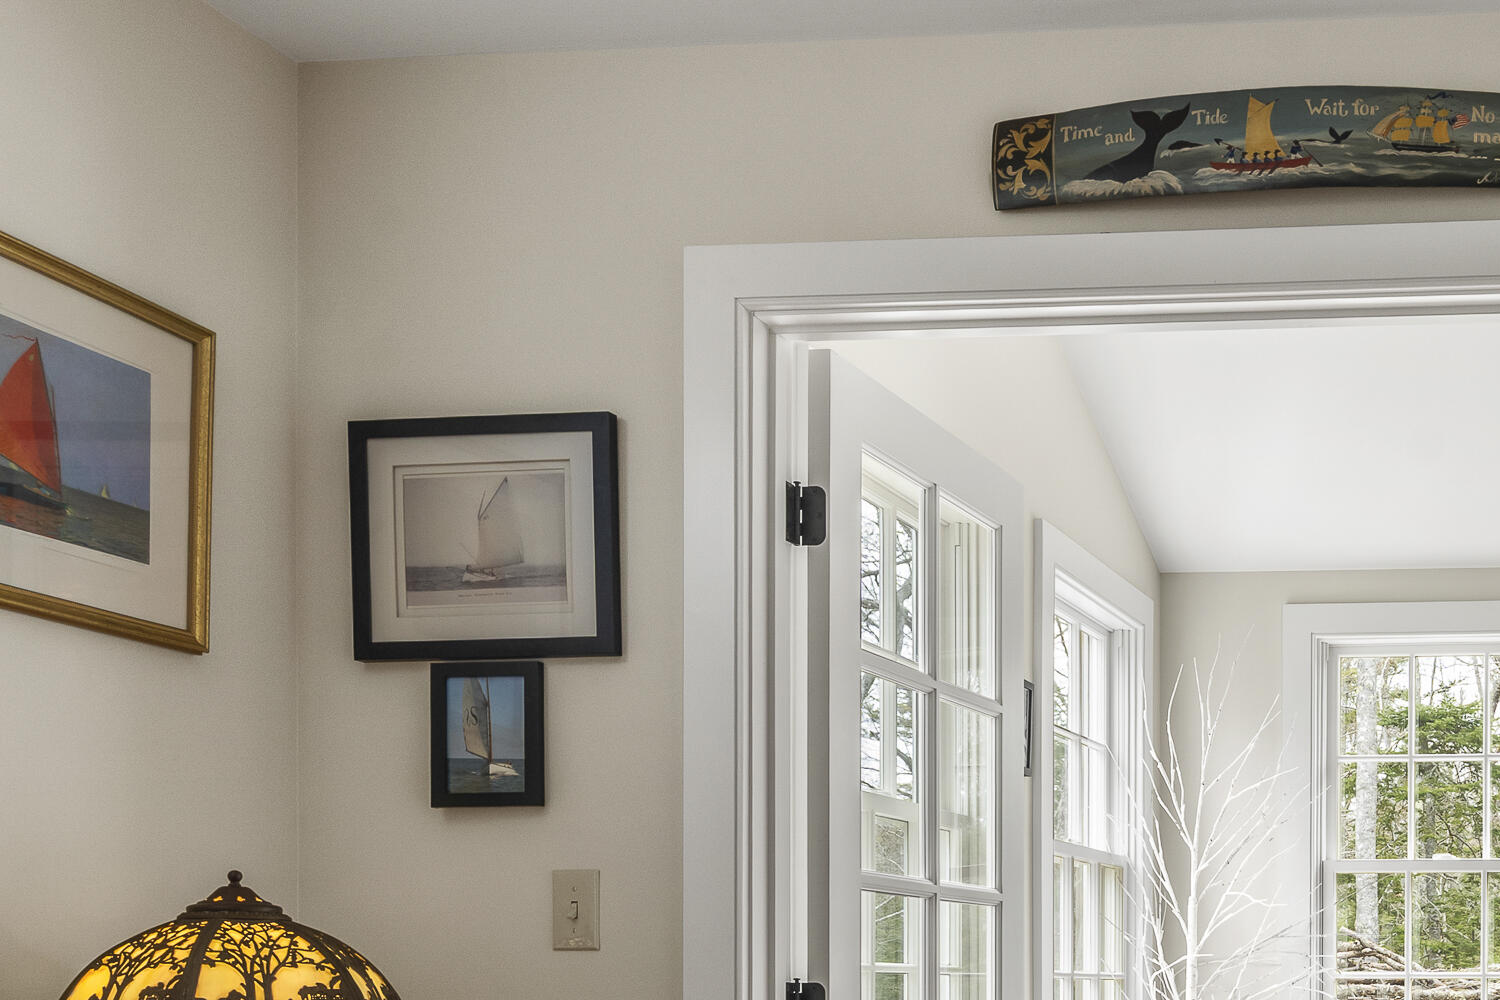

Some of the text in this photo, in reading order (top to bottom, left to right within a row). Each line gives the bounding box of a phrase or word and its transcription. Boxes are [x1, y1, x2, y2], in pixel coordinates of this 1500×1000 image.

[1305, 98, 1379, 116] Wait for
[1472, 105, 1495, 123] No
[1191, 109, 1228, 126] Tide
[1060, 125, 1136, 146] Time and
